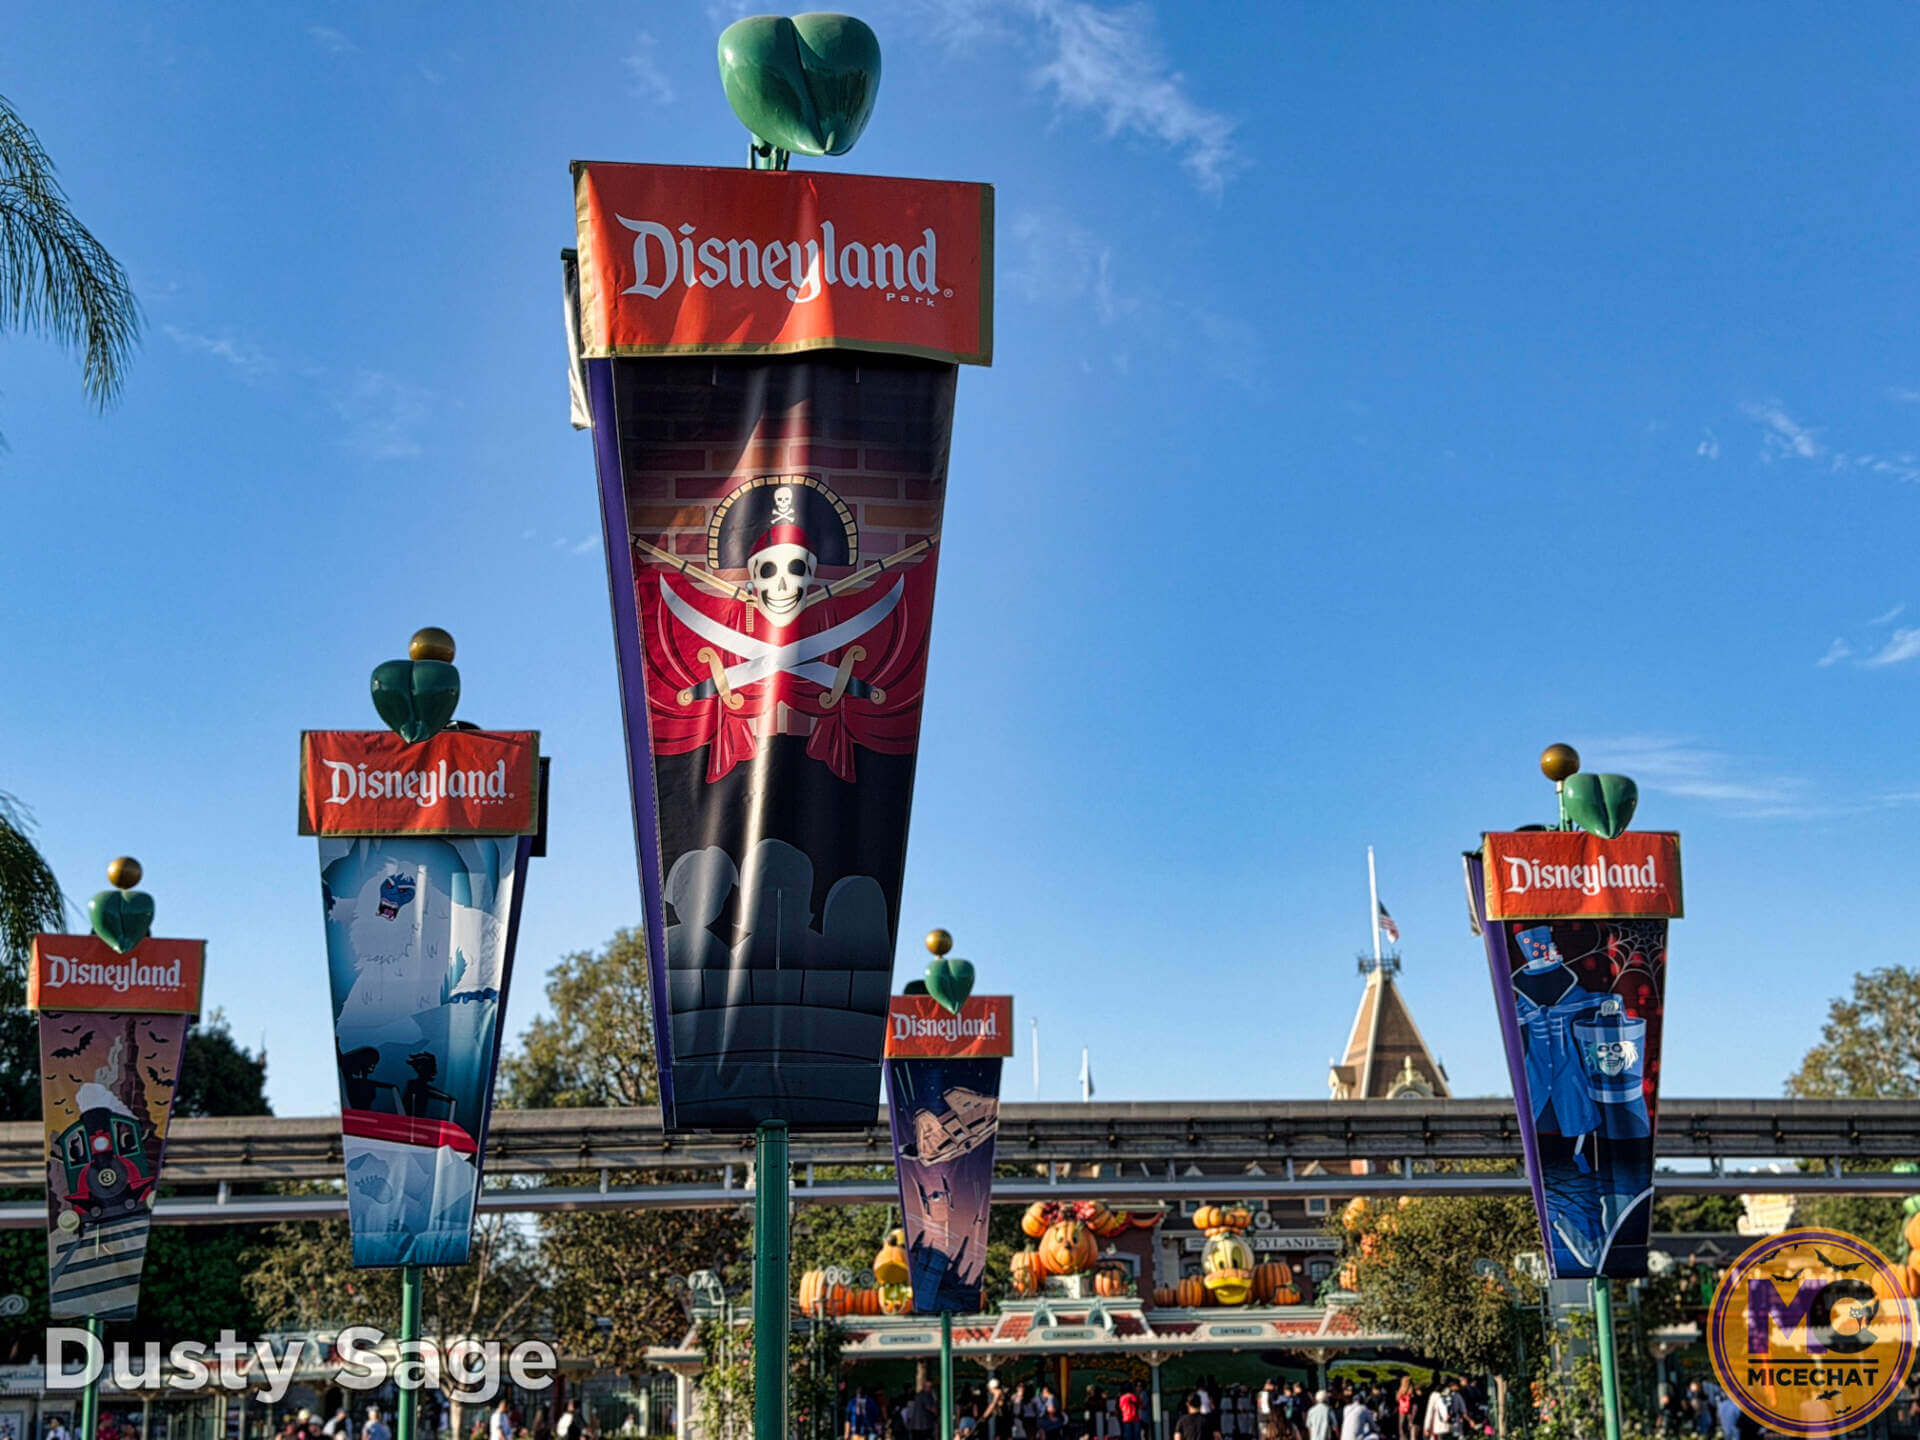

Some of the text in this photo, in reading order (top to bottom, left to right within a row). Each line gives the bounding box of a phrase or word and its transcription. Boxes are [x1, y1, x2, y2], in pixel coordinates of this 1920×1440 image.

[614, 211, 940, 304] Disneyland
[885, 291, 935, 308] Park
[321, 758, 507, 808] Disneyland
[1501, 854, 1658, 897] Disneyland
[43, 952, 182, 993] Disneyland
[890, 1011, 997, 1042] Disneyland
